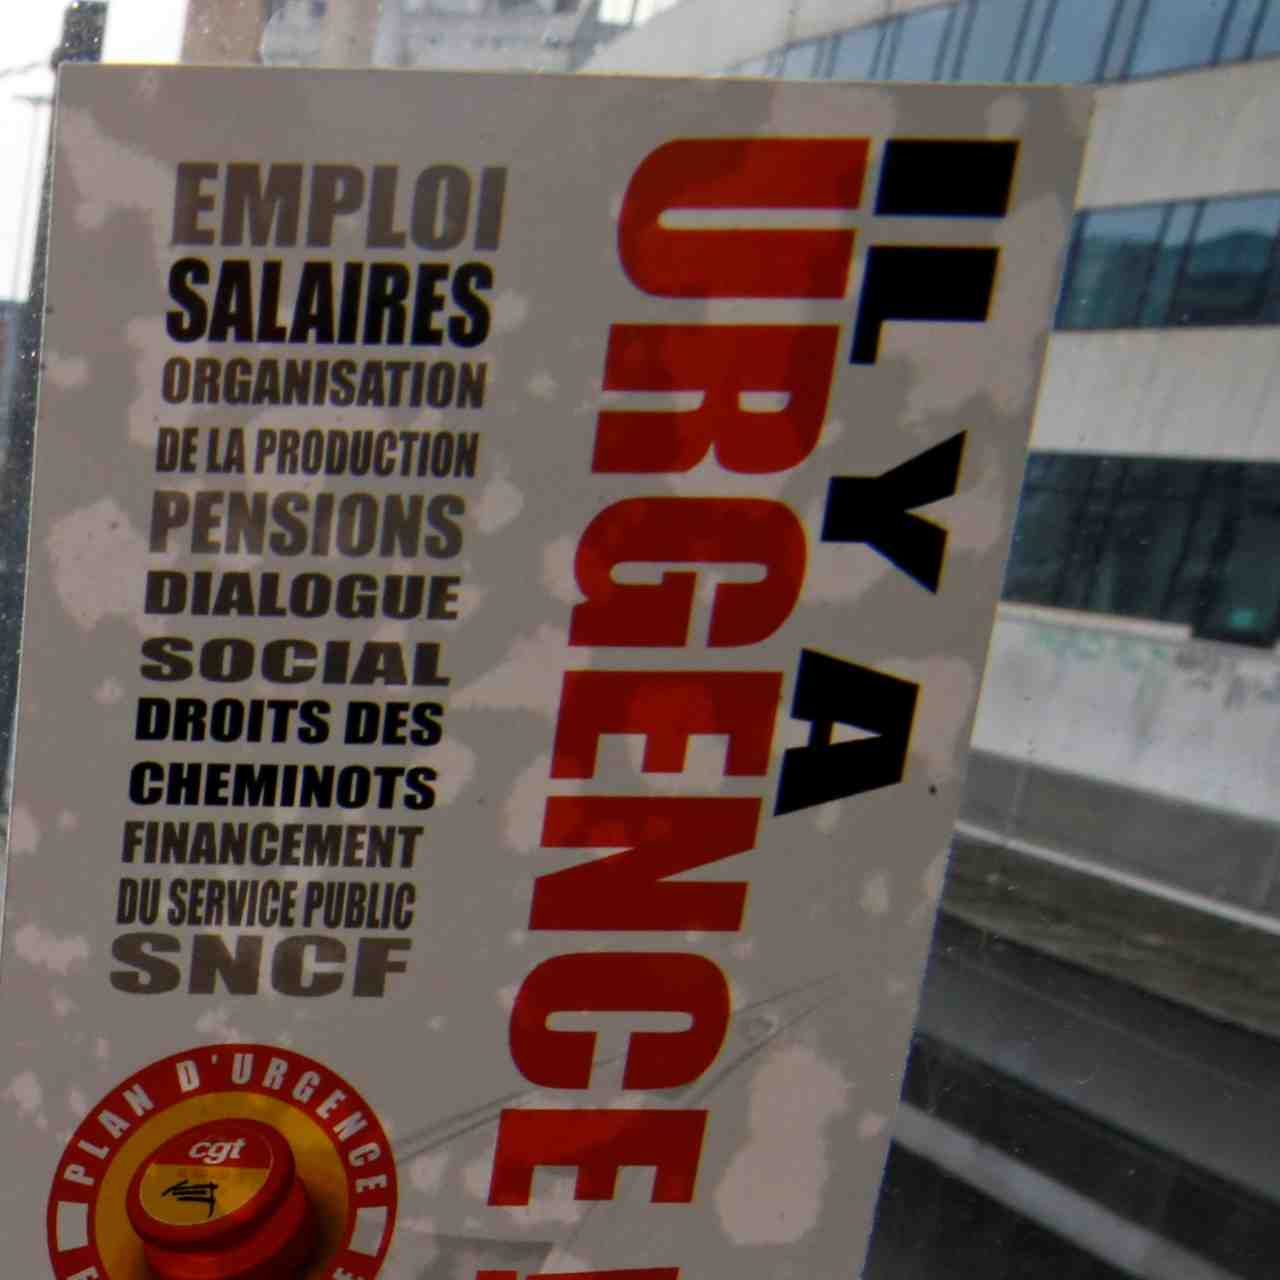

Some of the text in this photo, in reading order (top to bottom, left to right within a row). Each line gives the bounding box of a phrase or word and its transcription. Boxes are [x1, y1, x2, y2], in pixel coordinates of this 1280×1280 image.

[170, 161, 509, 252] EMPLOI
[164, 257, 494, 348] SALAIRES
[161, 356, 488, 409] ORGANISATION
[155, 427, 480, 479] DE LA PRODUCTION
[772, 138, 1020, 817] IL Y A
[148, 490, 466, 559] PENSIONS
[144, 570, 461, 621] DIALOGUE
[140, 636, 451, 687] SOCIAL
[134, 697, 444, 746] DROITS DES
[128, 761, 438, 810] CHEMINOTS
[121, 820, 424, 869] FINANCEMENT
[116, 878, 417, 931] DU SERVICE PUBLIC
[109, 932, 414, 999] SNCF
[63, 1053, 389, 1193] PLAN D'URGENCE
[189, 1137, 247, 1165] cgt
